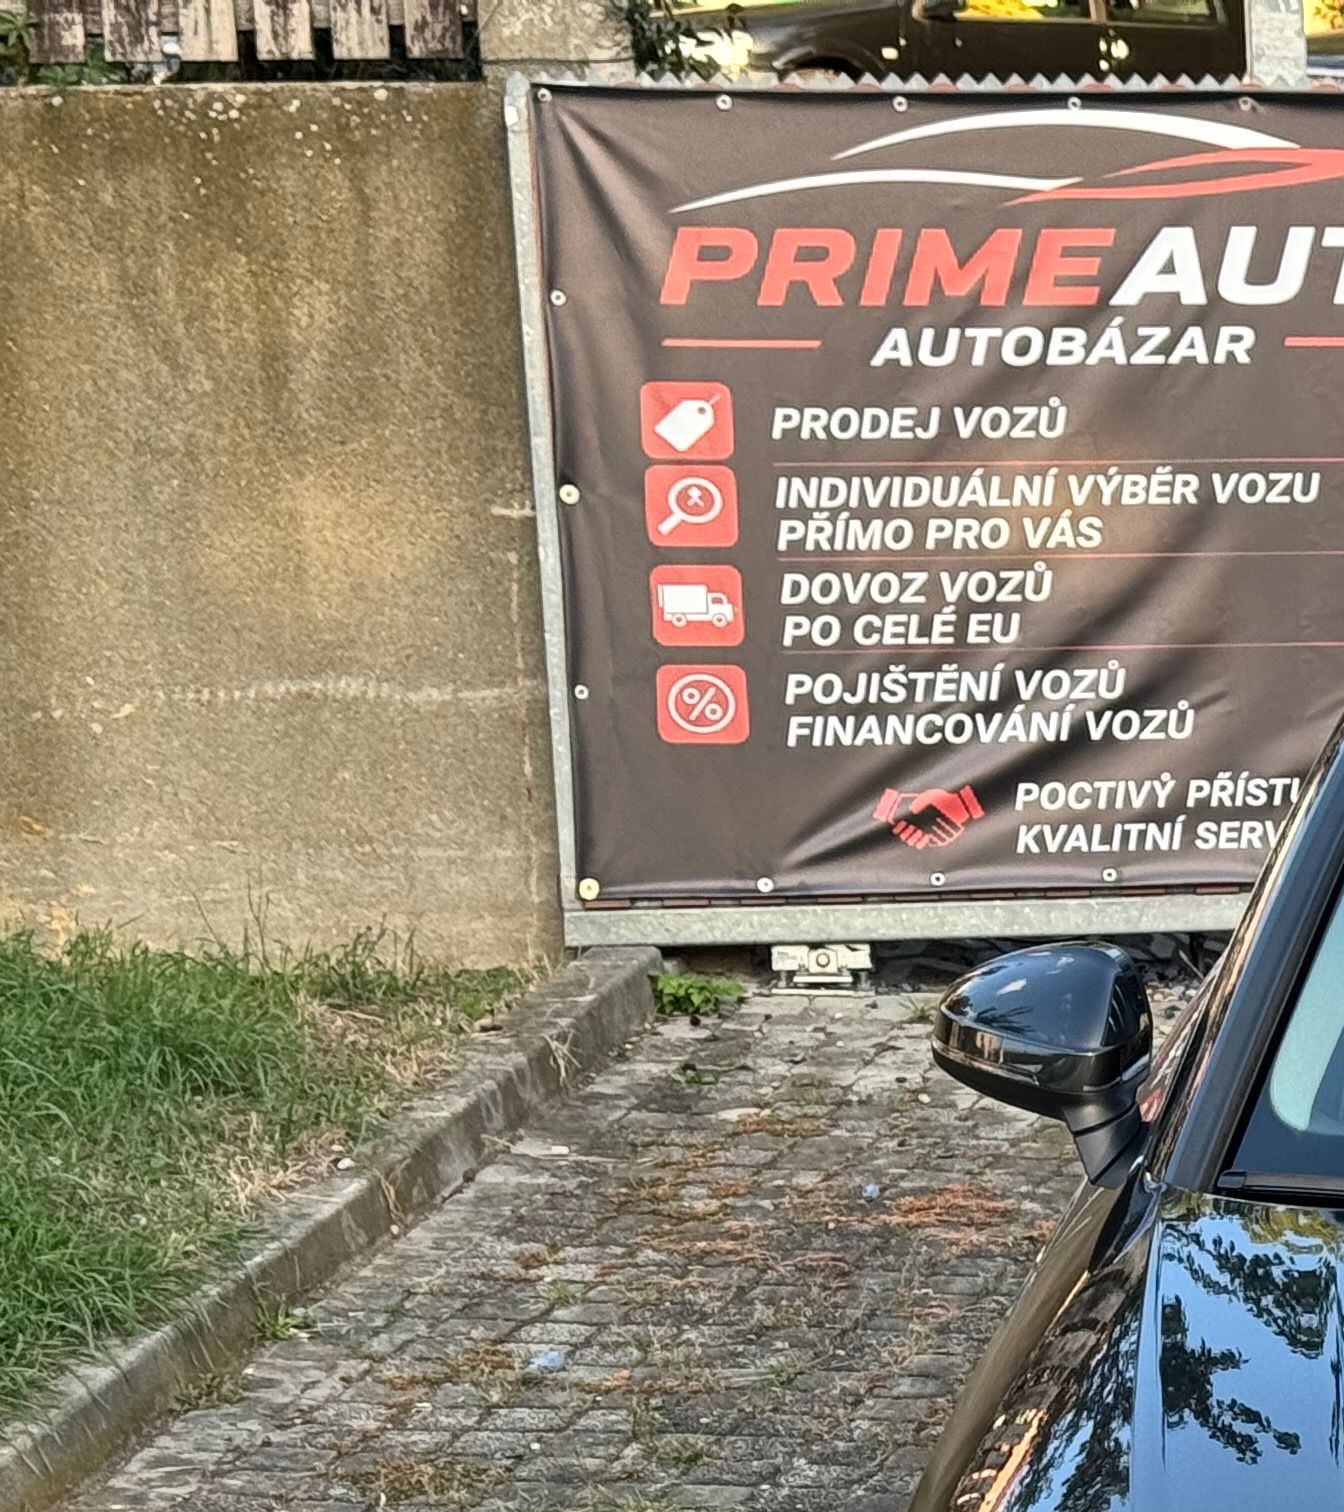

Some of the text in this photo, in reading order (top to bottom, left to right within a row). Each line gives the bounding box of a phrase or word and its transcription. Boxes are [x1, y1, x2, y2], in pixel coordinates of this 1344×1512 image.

[870, 318, 1256, 367] AUTOBÁZAR
[771, 396, 1067, 440] PRODEJ VOZŮ
[775, 465, 1321, 509] INDIVIDUÁLNÍ VÝBĚR VOZU
[777, 508, 1103, 552] PŘÍMO PRO VÁS
[780, 560, 1053, 605] DOVOZ VOZŮ
[782, 603, 1021, 647] PO CELÉ EU
[785, 659, 1127, 705] POJIŠTĚNÍ VOZŮ
[787, 699, 1195, 748] FINANCOVÁNÍ VOZŮ
[1016, 814, 1186, 854] KVALITNÍ
